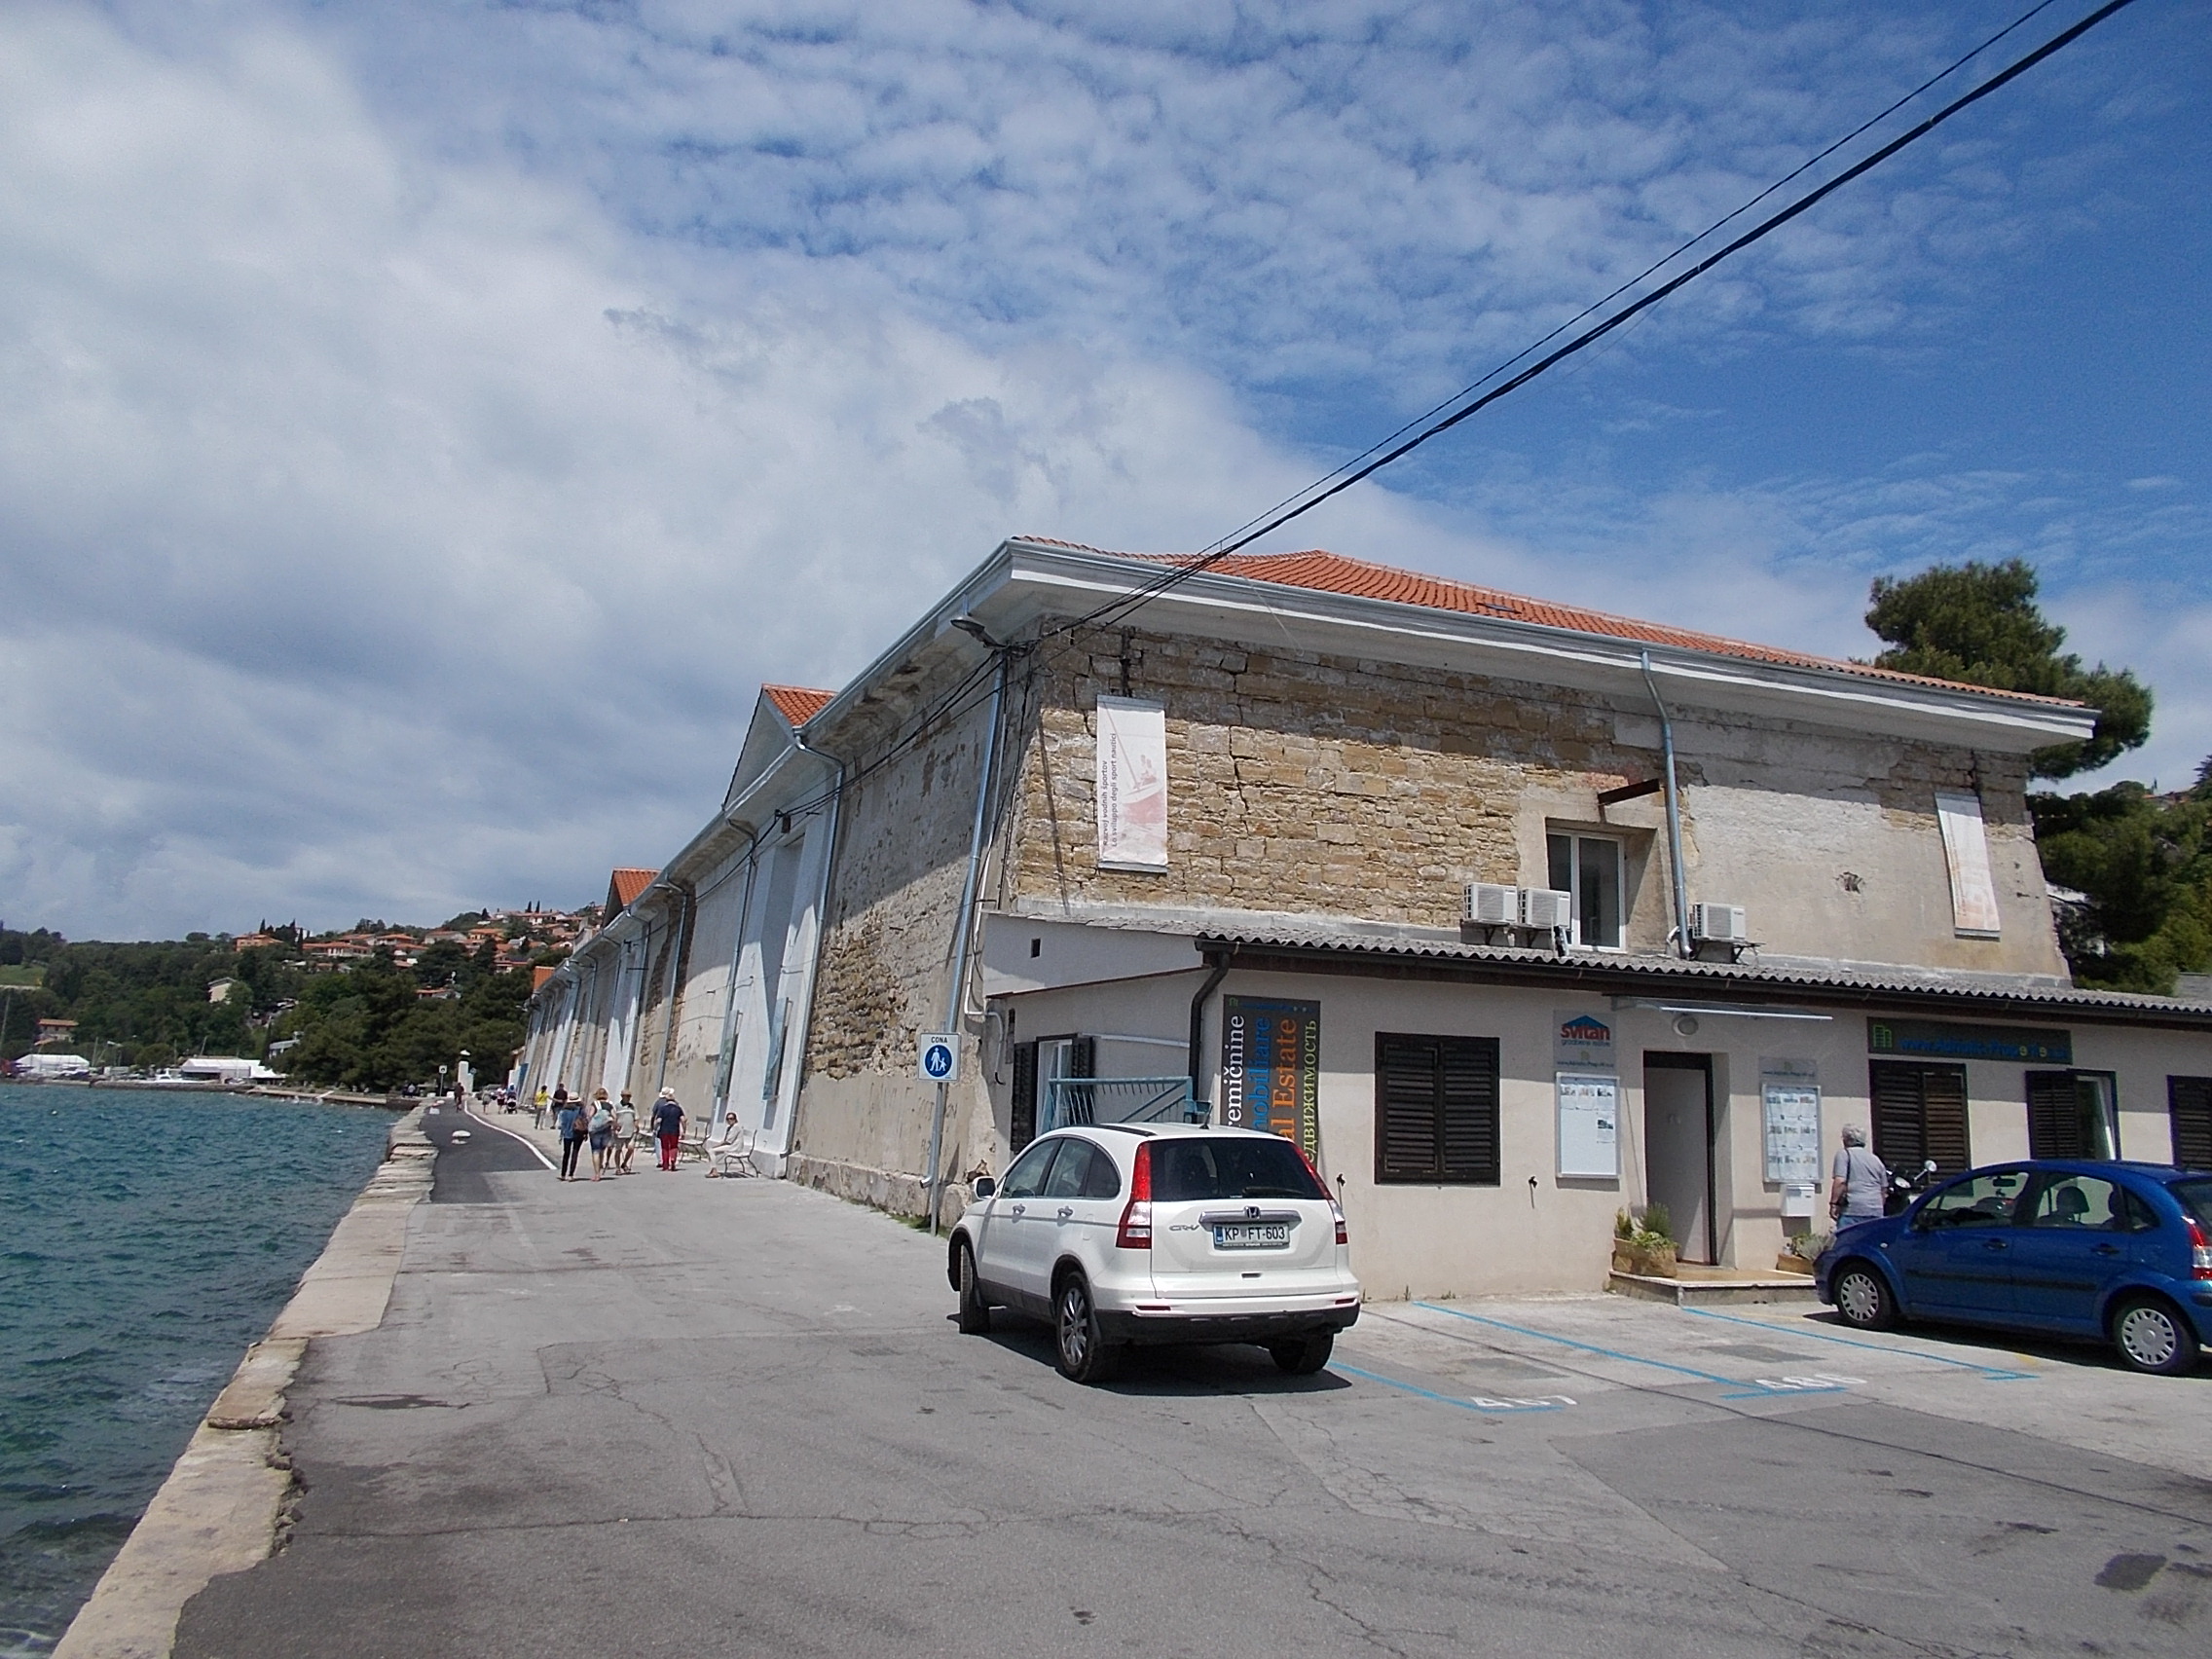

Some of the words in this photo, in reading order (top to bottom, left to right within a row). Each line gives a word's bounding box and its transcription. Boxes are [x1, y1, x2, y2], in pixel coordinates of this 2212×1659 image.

[1111, 838, 1118, 847] Lo
[1560, 1023, 1611, 1041] svitan
[1272, 1018, 1297, 1109] Estate
[1225, 1227, 1239, 1240] KP
[1248, 1226, 1285, 1240] FT-603
